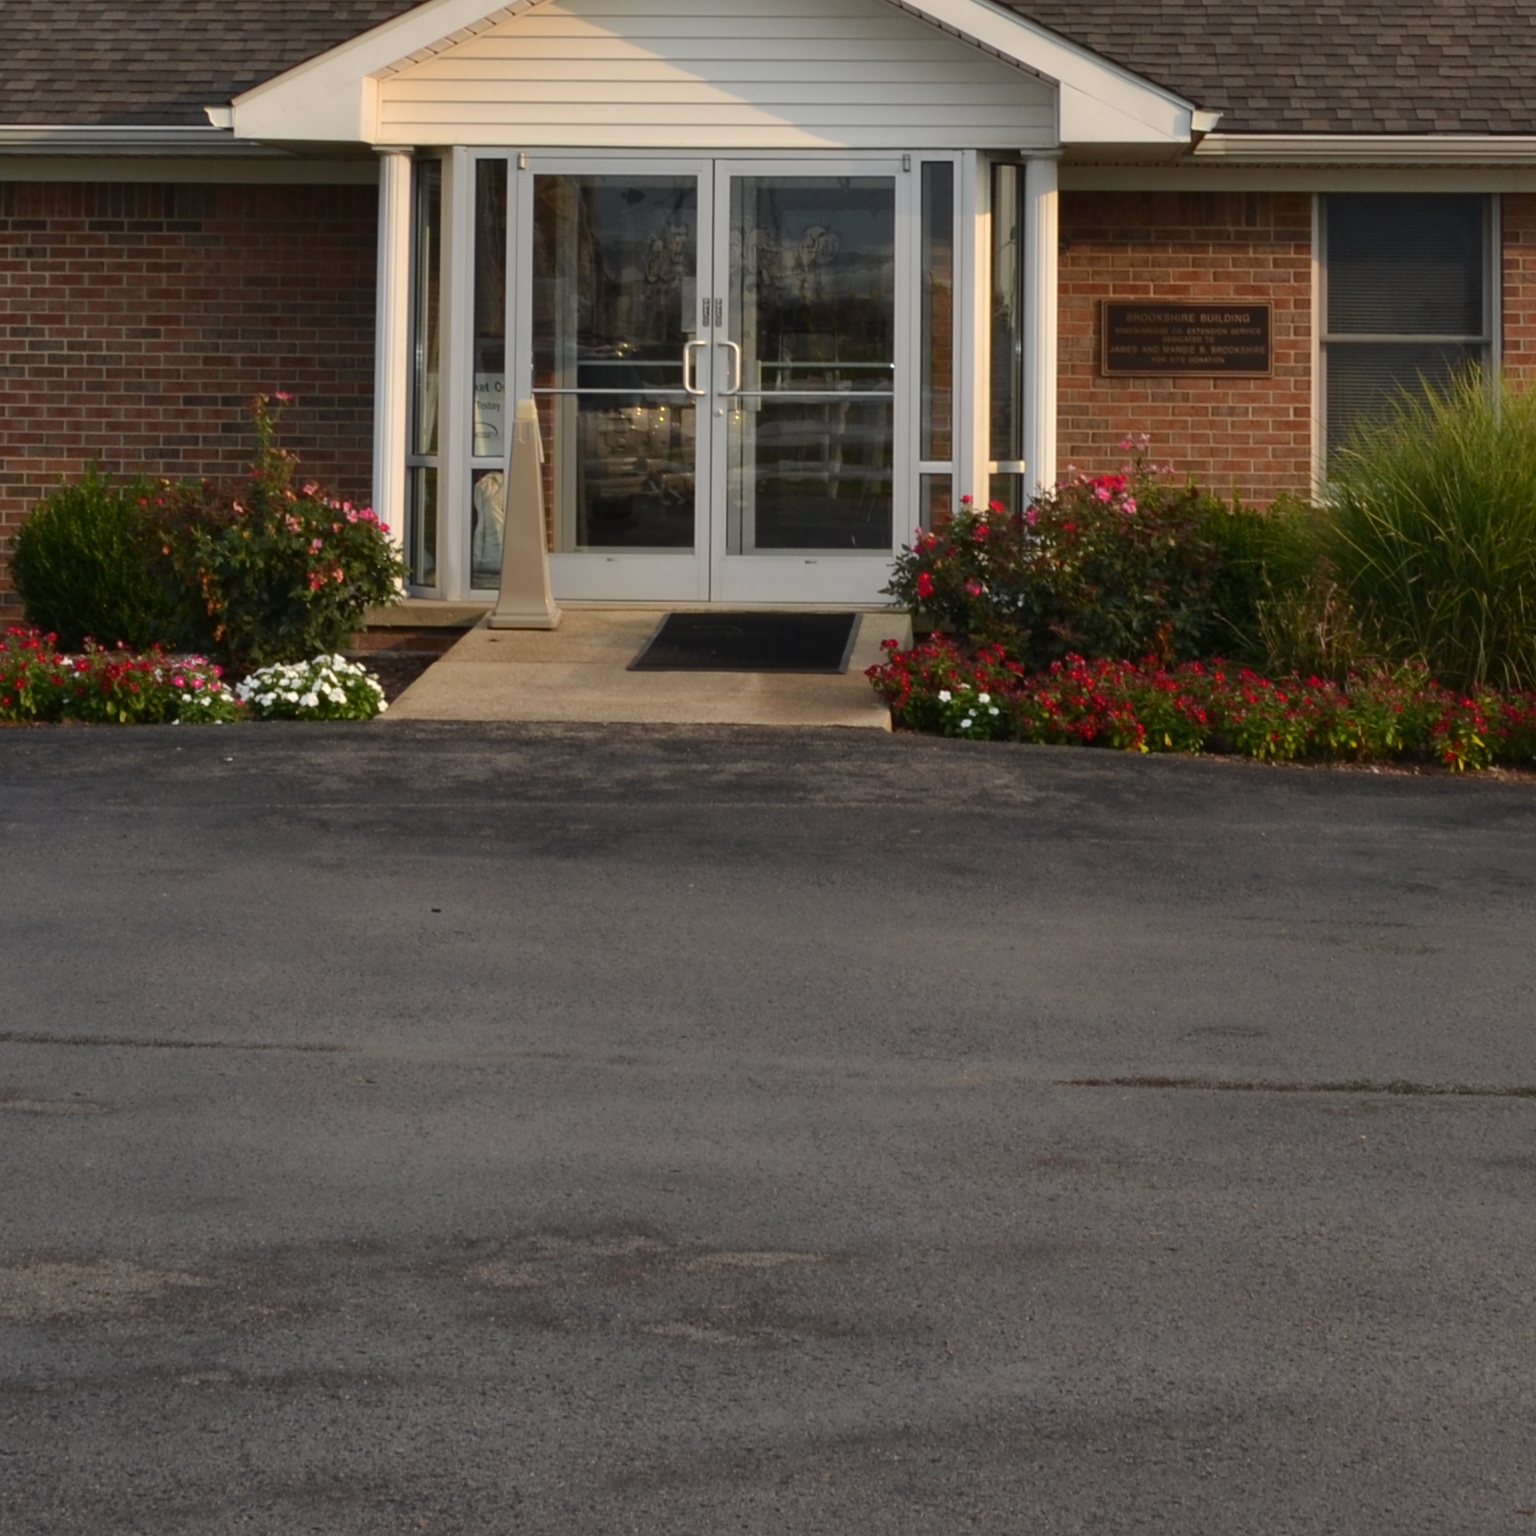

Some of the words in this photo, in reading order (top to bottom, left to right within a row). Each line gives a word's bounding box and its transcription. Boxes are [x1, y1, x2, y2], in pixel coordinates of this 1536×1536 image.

[1125, 313, 1195, 323] BROOKSHIRE
[1200, 313, 1251, 323] BUILDING
[1186, 327, 1228, 335] EXTENSION
[1230, 327, 1262, 335] SERVICE
[1109, 345, 1138, 354] JAMES
[1141, 345, 1160, 354] AND
[1210, 345, 1266, 354] BROOKSHIRE
[477, 400, 500, 412] Today
